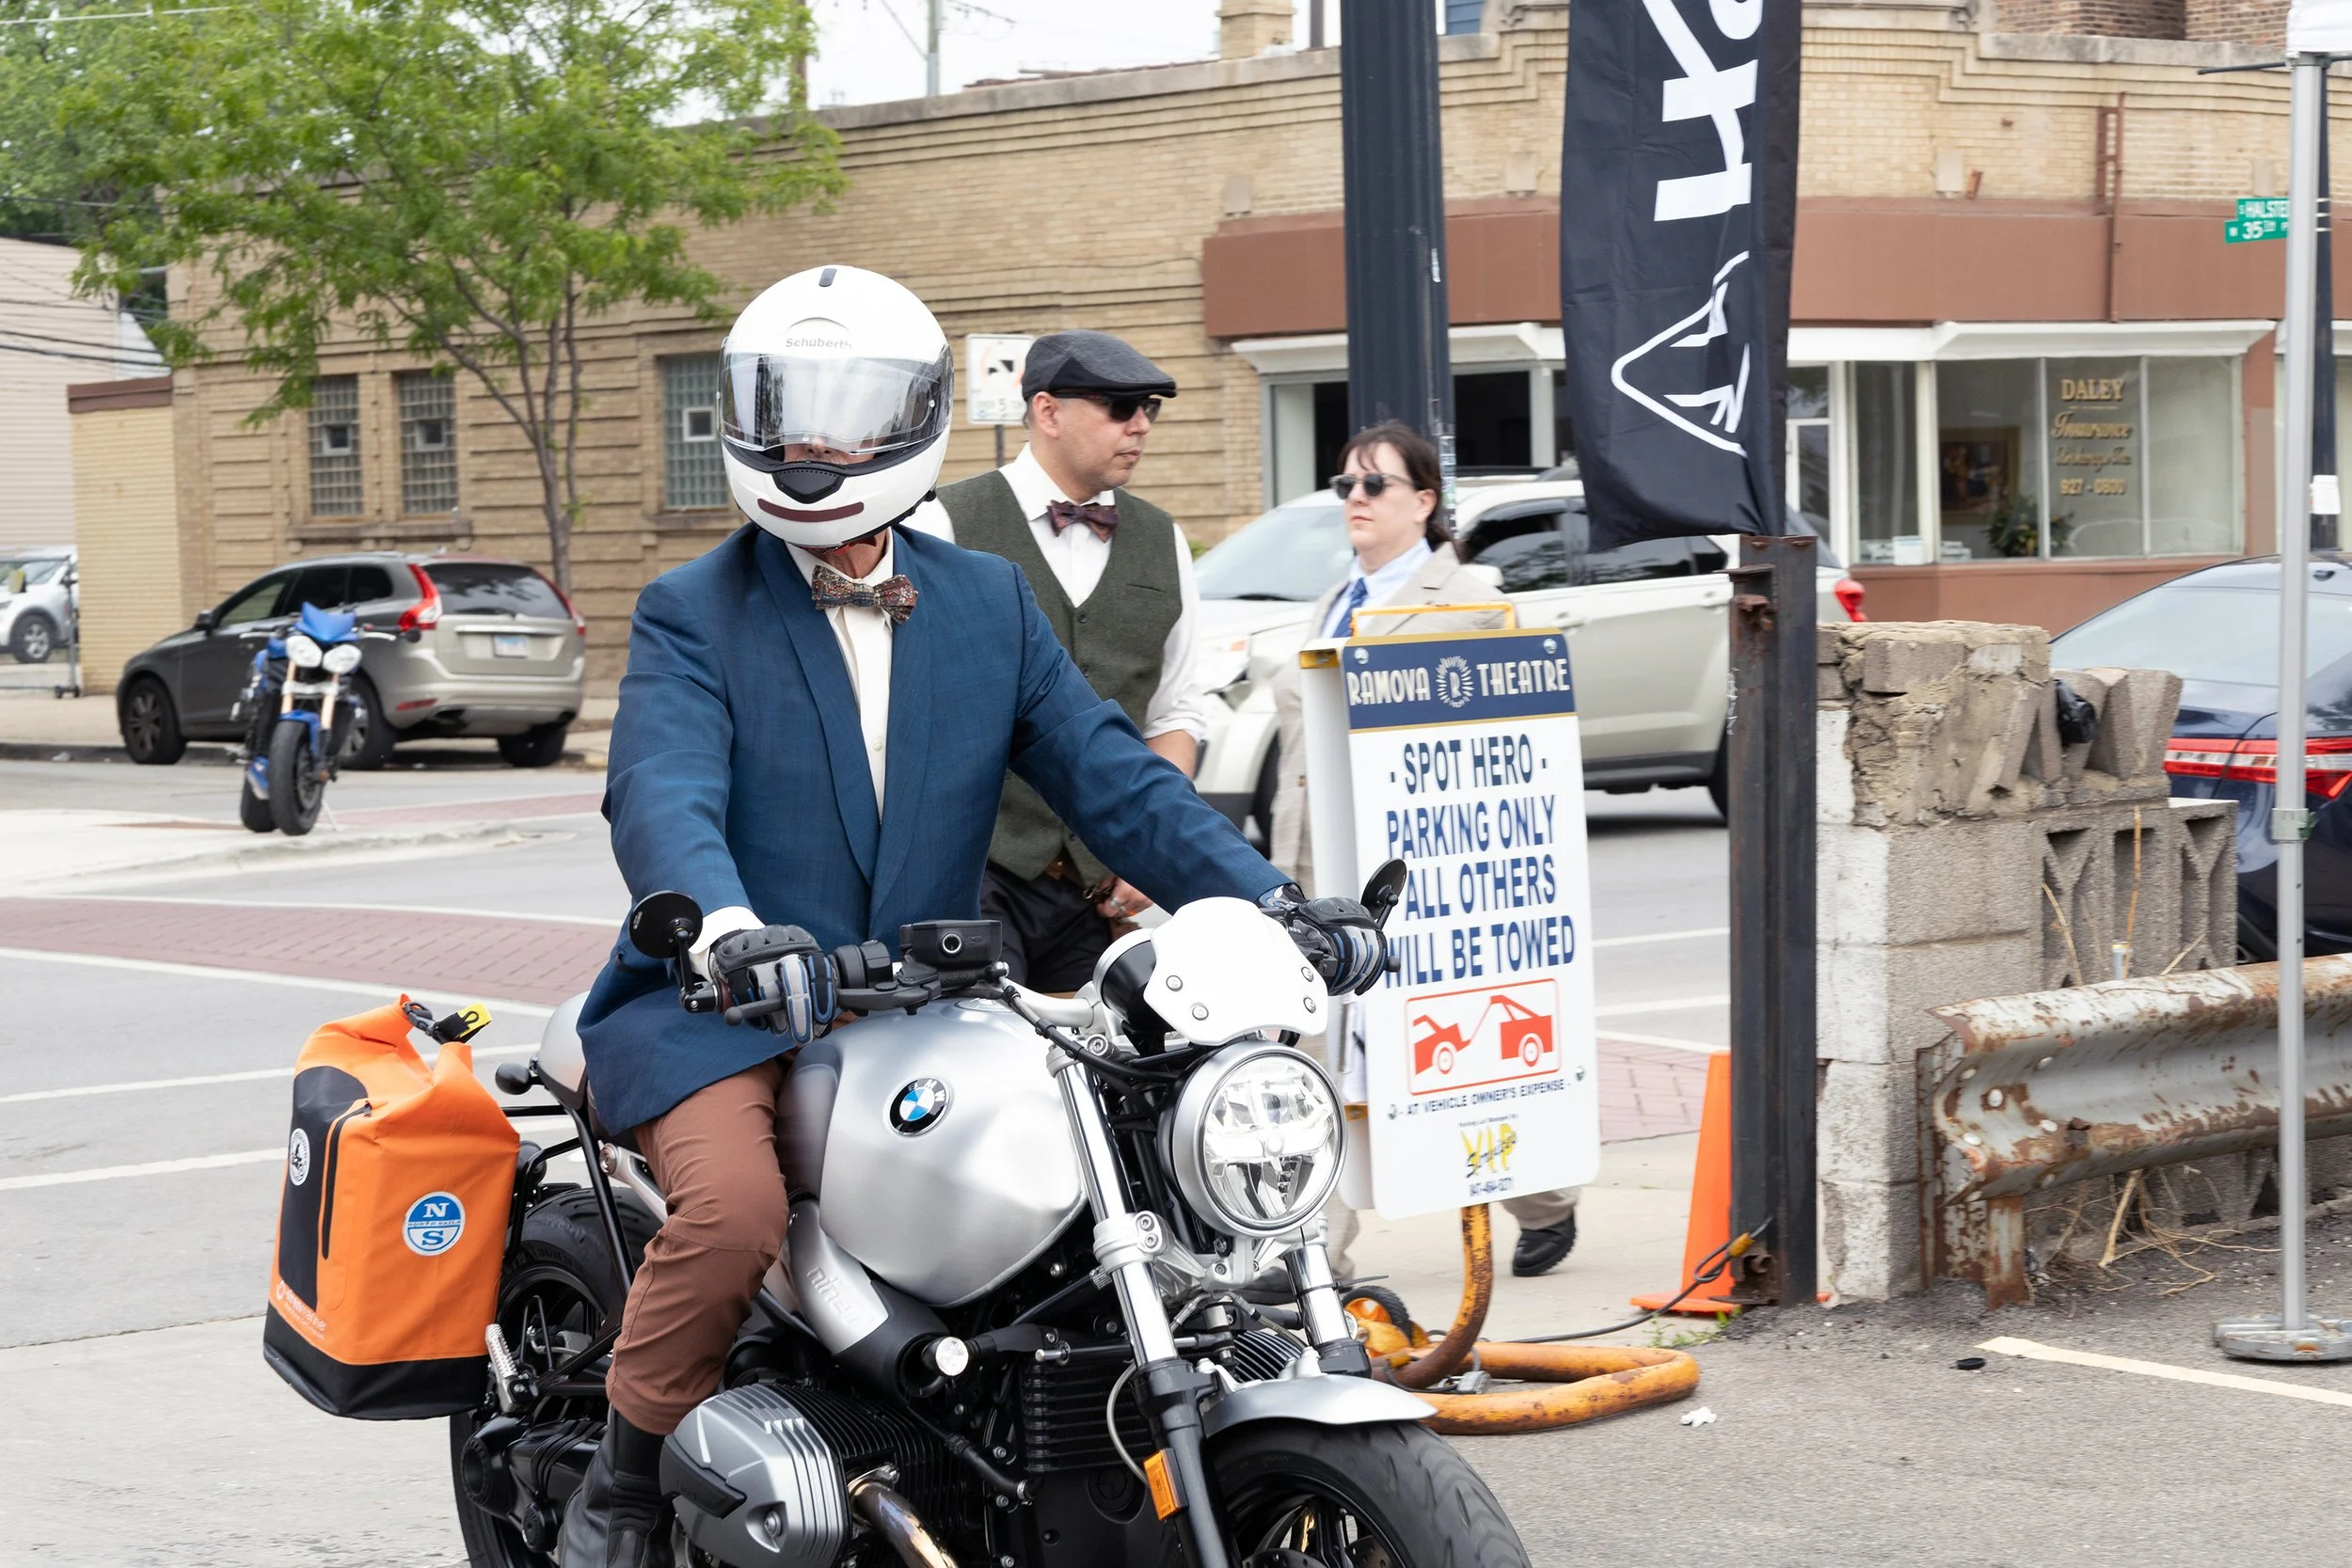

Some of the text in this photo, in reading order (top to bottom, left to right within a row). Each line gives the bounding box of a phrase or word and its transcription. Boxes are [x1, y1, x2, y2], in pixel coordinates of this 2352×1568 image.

[2245, 200, 2290, 218] HALSTE
[786, 338, 852, 350] Schuberth
[2060, 378, 2124, 402] DALEY
[1346, 667, 1431, 705] RAMOVA
[1476, 658, 1570, 697] THEATRE
[1404, 734, 1533, 795] SPOT HERO
[1386, 795, 1555, 861] PARKING ONLY
[1406, 854, 1556, 922] ALL OTHERS
[1452, 927, 1484, 980] BE
[1490, 915, 1576, 974] TOWED
[908, 1078, 946, 1102] BMW
[1406, 1079, 1565, 1116] AT VEHICLE OWNER'S EXPENSE
[1460, 1122, 1518, 1175] VIP
[422, 1202, 450, 1218] N
[421, 1229, 444, 1246] S
